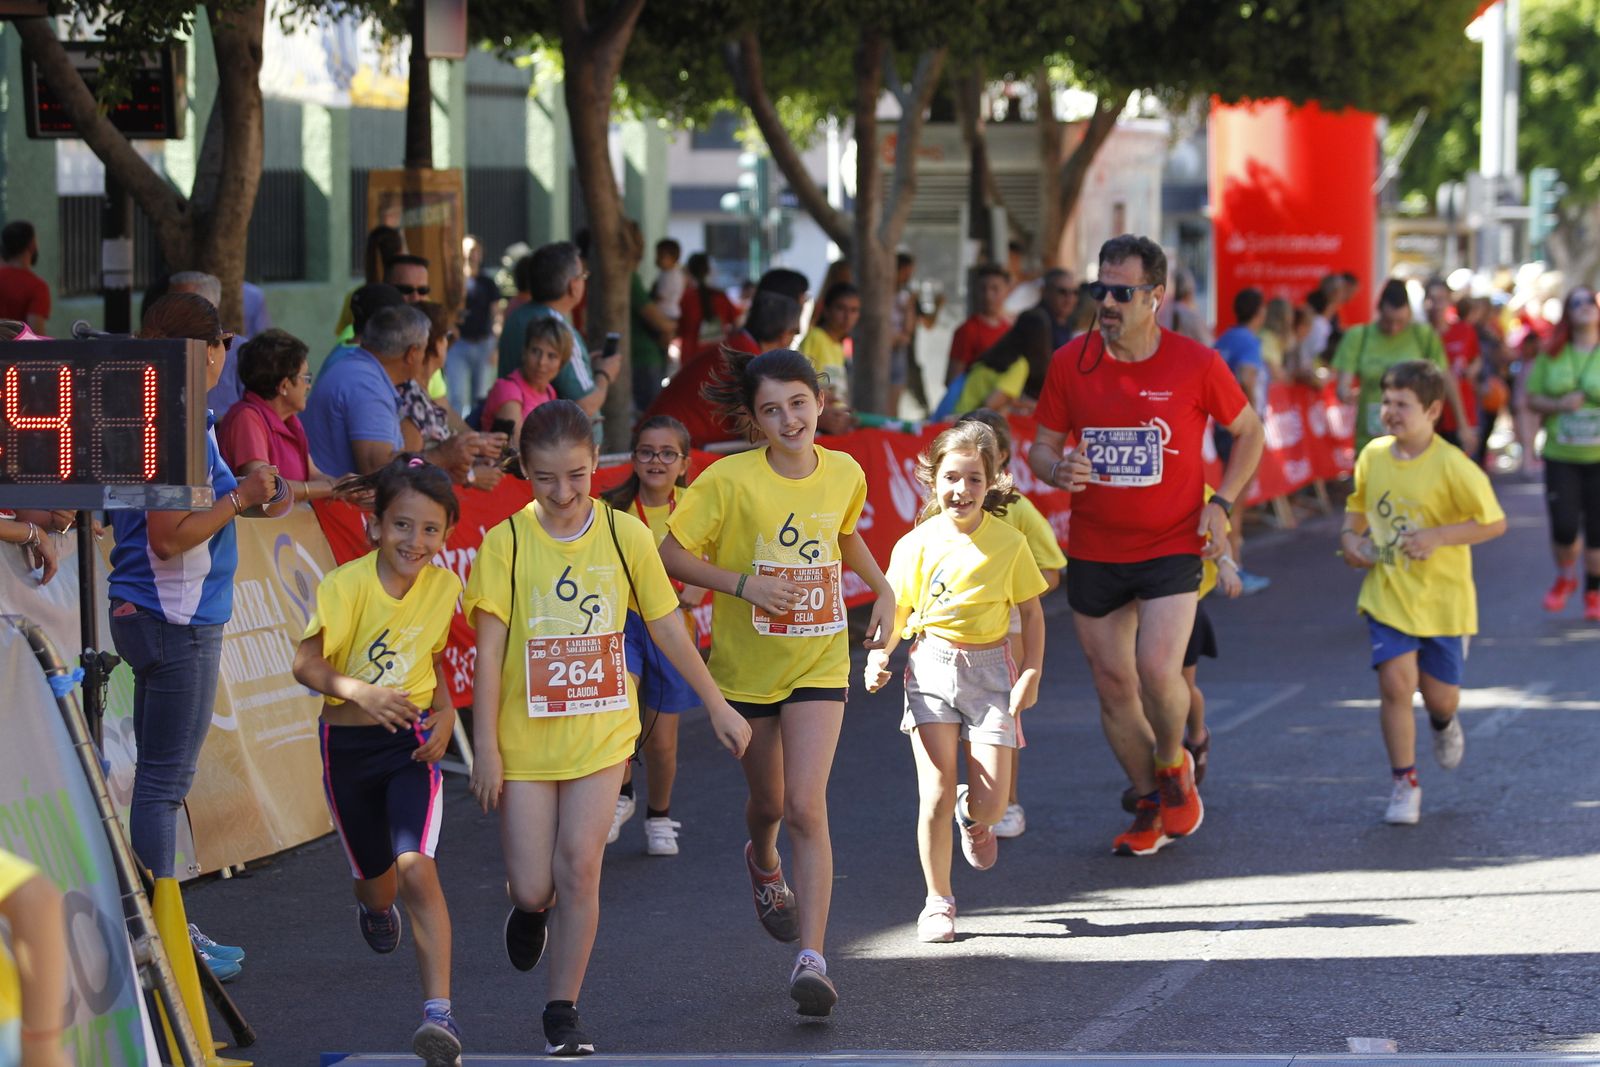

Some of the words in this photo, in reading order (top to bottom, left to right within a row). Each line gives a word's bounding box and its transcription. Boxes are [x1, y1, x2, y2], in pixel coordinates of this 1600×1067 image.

[6, 366, 157, 480] 41
[1092, 445, 1148, 465] 2075
[1377, 490, 1392, 518] 6
[779, 512, 799, 547] 6
[556, 565, 578, 602] 6
[794, 613, 814, 623] CELIA
[550, 639, 561, 656] 6
[548, 659, 605, 686] 264
[567, 686, 599, 698] CLAUDIA
